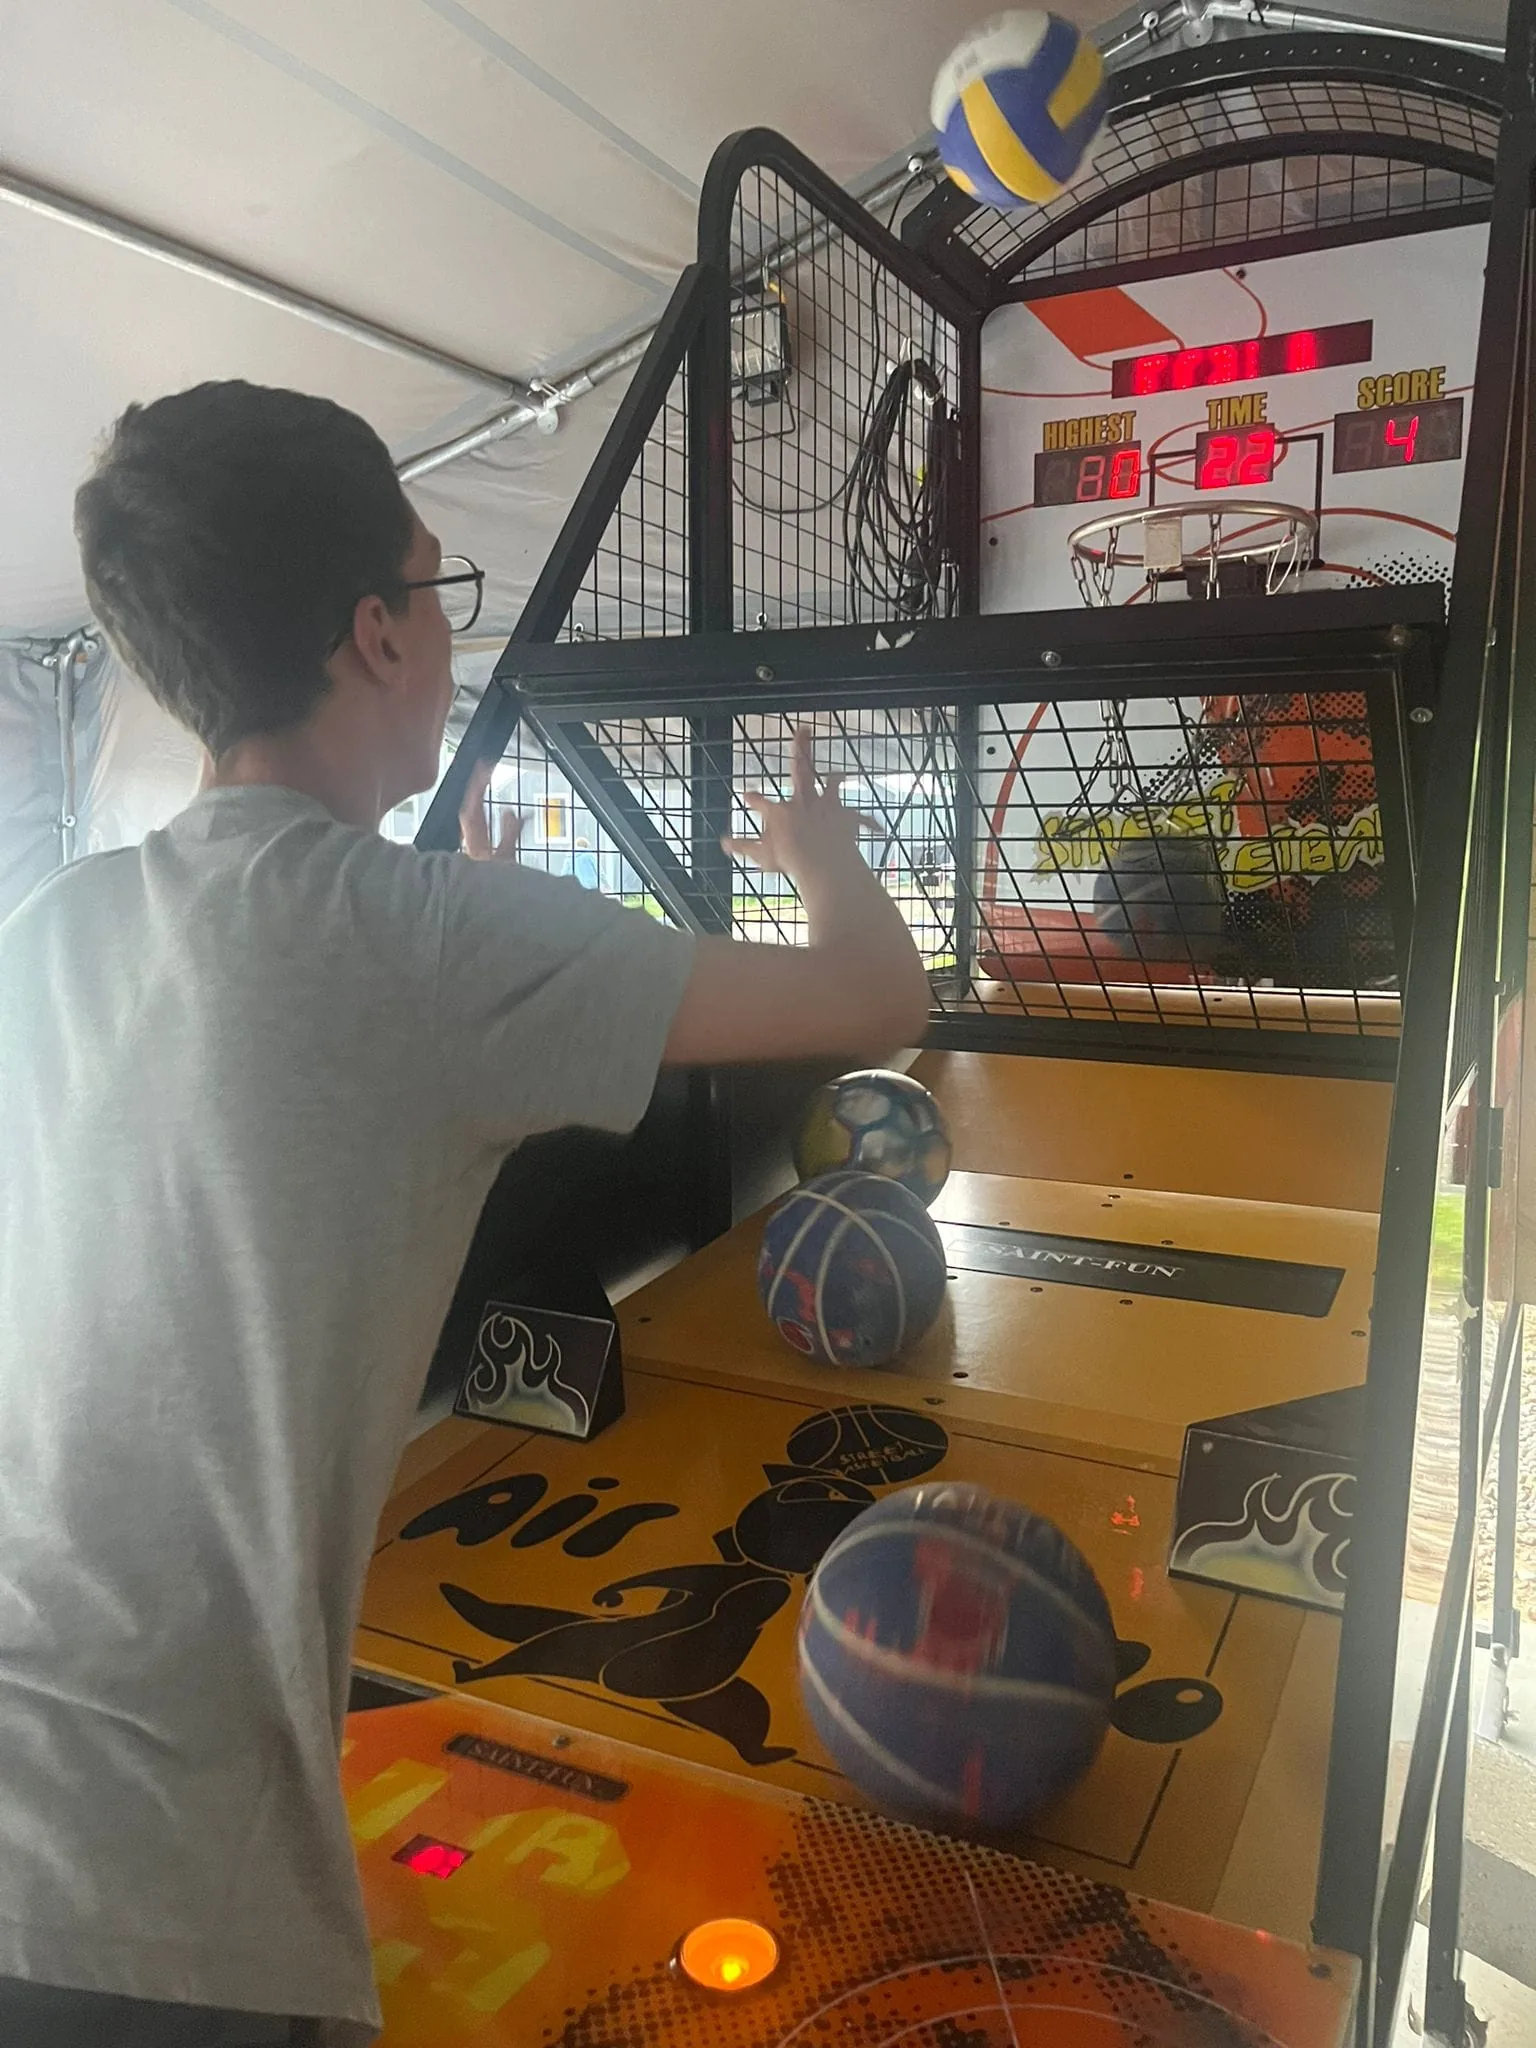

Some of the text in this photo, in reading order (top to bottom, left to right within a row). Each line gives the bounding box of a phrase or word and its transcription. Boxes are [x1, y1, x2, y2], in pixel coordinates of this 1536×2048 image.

[1358, 366, 1446, 410] SCORE
[1043, 411, 1136, 452] HIGHEST
[1206, 392, 1268, 431] TIME
[1386, 415, 1418, 463] 4
[1200, 432, 1274, 490] 22
[984, 1243, 1184, 1277] SAINT-FUN
